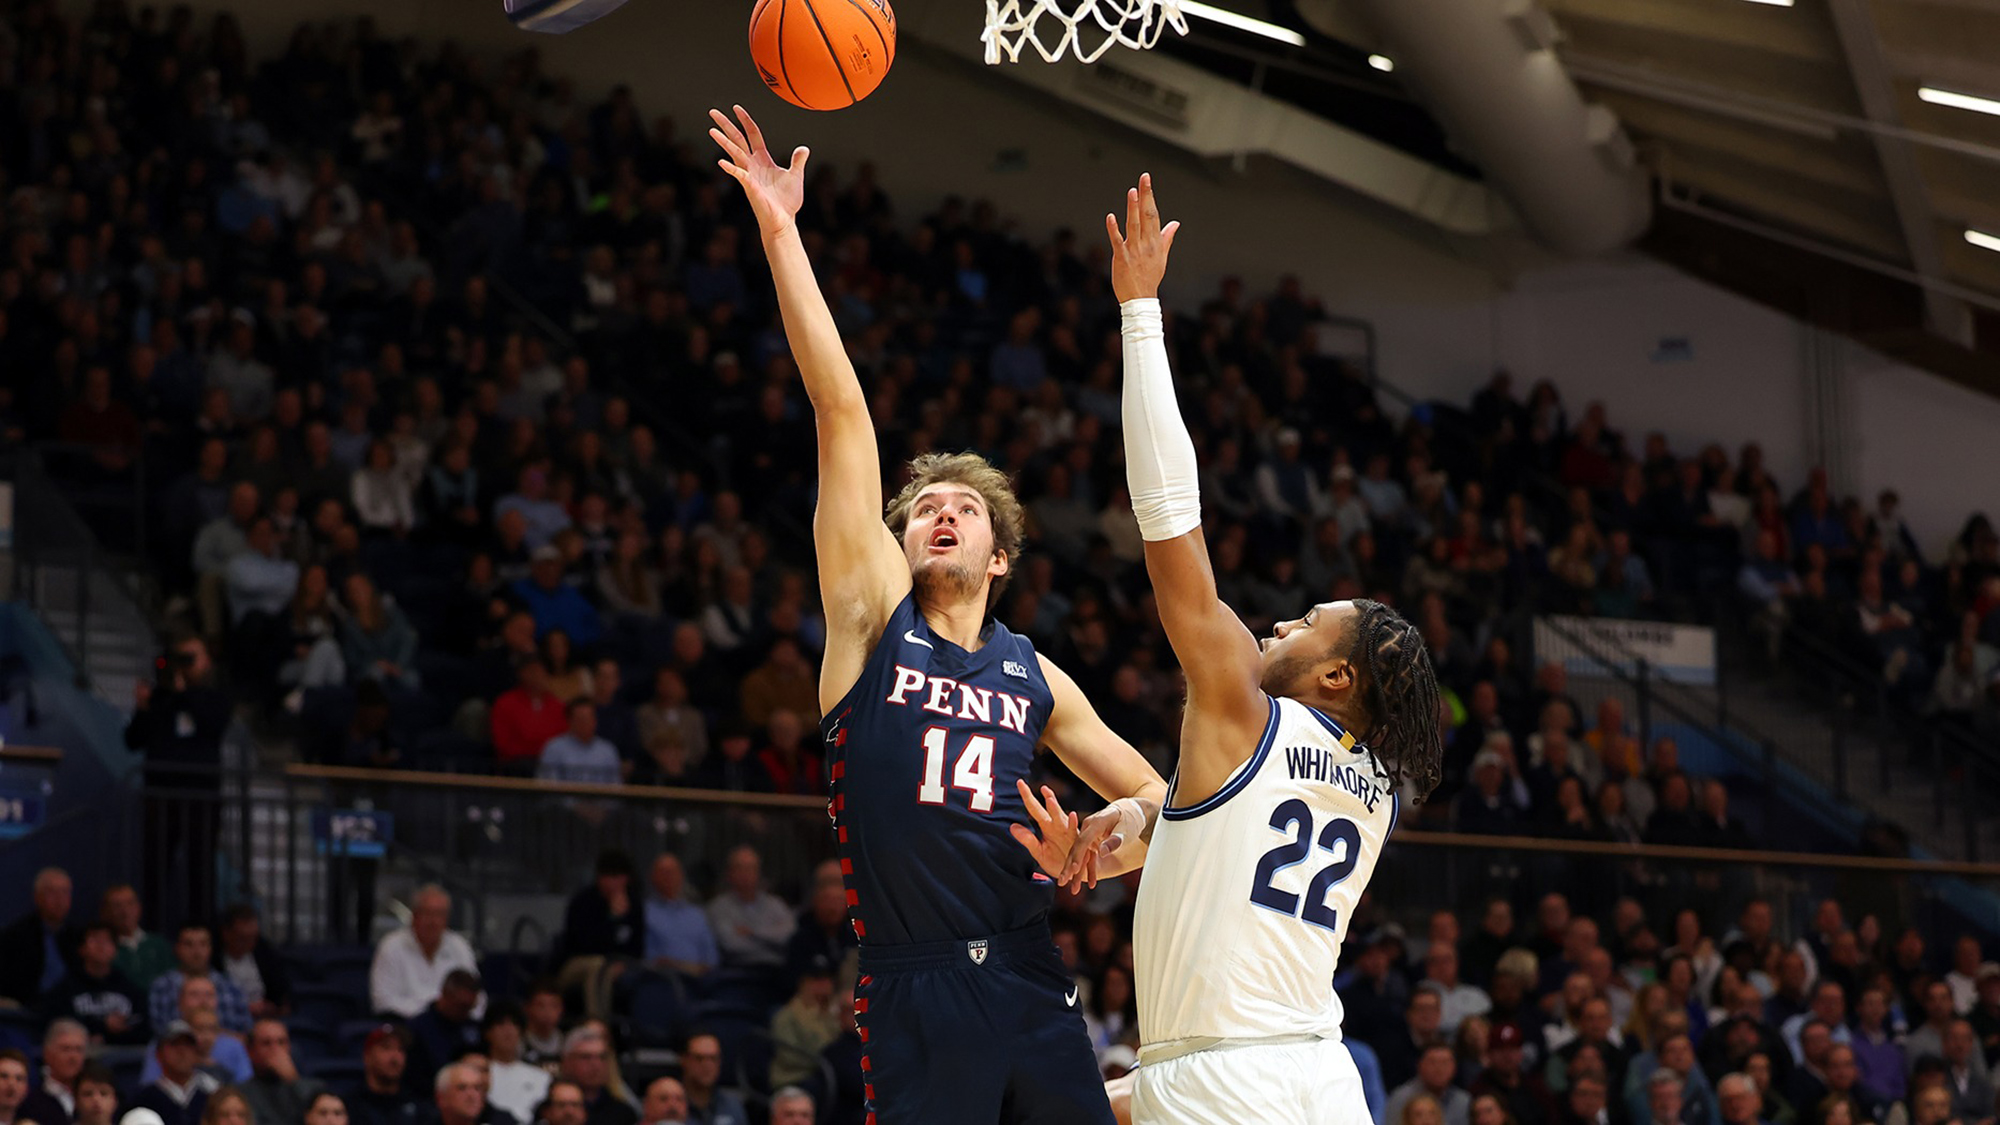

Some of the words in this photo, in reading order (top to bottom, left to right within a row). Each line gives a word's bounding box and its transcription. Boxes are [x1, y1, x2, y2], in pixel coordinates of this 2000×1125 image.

[886, 664, 1032, 736] PENN
[917, 724, 997, 814] 14
[1249, 798, 1362, 933] 22
[975, 949, 983, 959] P
